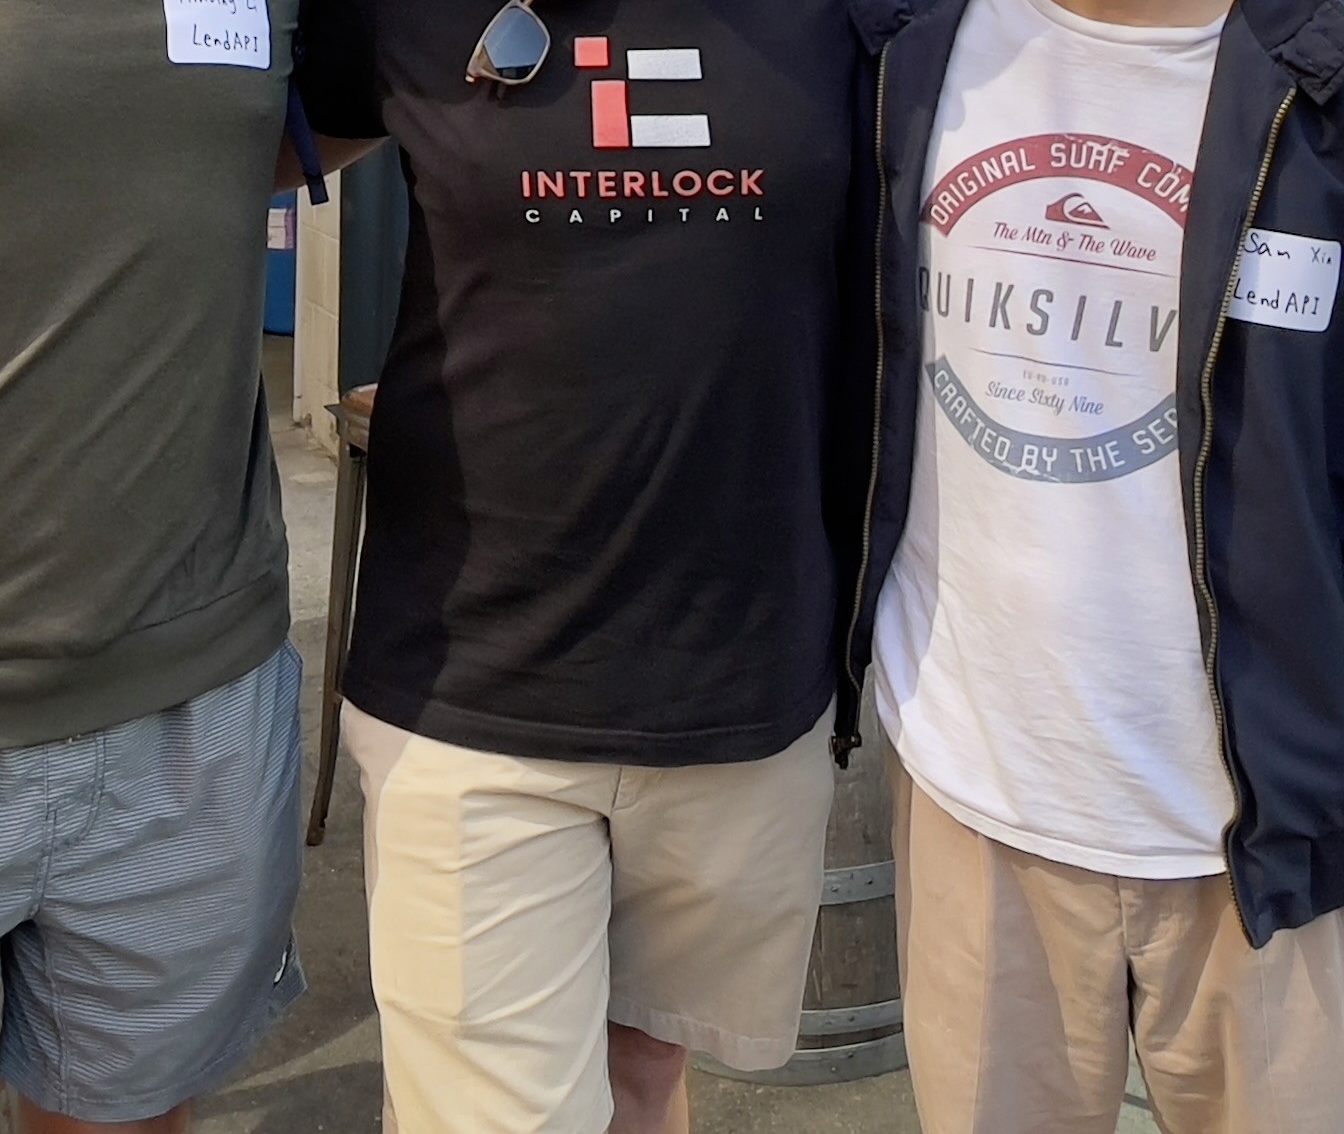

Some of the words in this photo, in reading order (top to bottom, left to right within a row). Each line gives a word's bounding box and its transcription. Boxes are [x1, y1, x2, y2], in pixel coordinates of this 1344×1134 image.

[521, 169, 764, 198] INTERLOCK
[930, 147, 1036, 226] ORIGINAL
[1050, 140, 1131, 174] SURF
[525, 207, 763, 223] CAPITAL
[993, 221, 1019, 242] The
[1021, 225, 1052, 246] Mtn
[1056, 231, 1074, 252] &
[1078, 233, 1105, 254] The
[1110, 238, 1157, 262] Wave
[984, 380, 1026, 402] Since
[1028, 387, 1065, 417] Sixty
[1068, 395, 1105, 416] Nine
[933, 369, 1012, 463] CRAFTED
[1020, 443, 1058, 473] BY
[1069, 440, 1126, 474] THE
